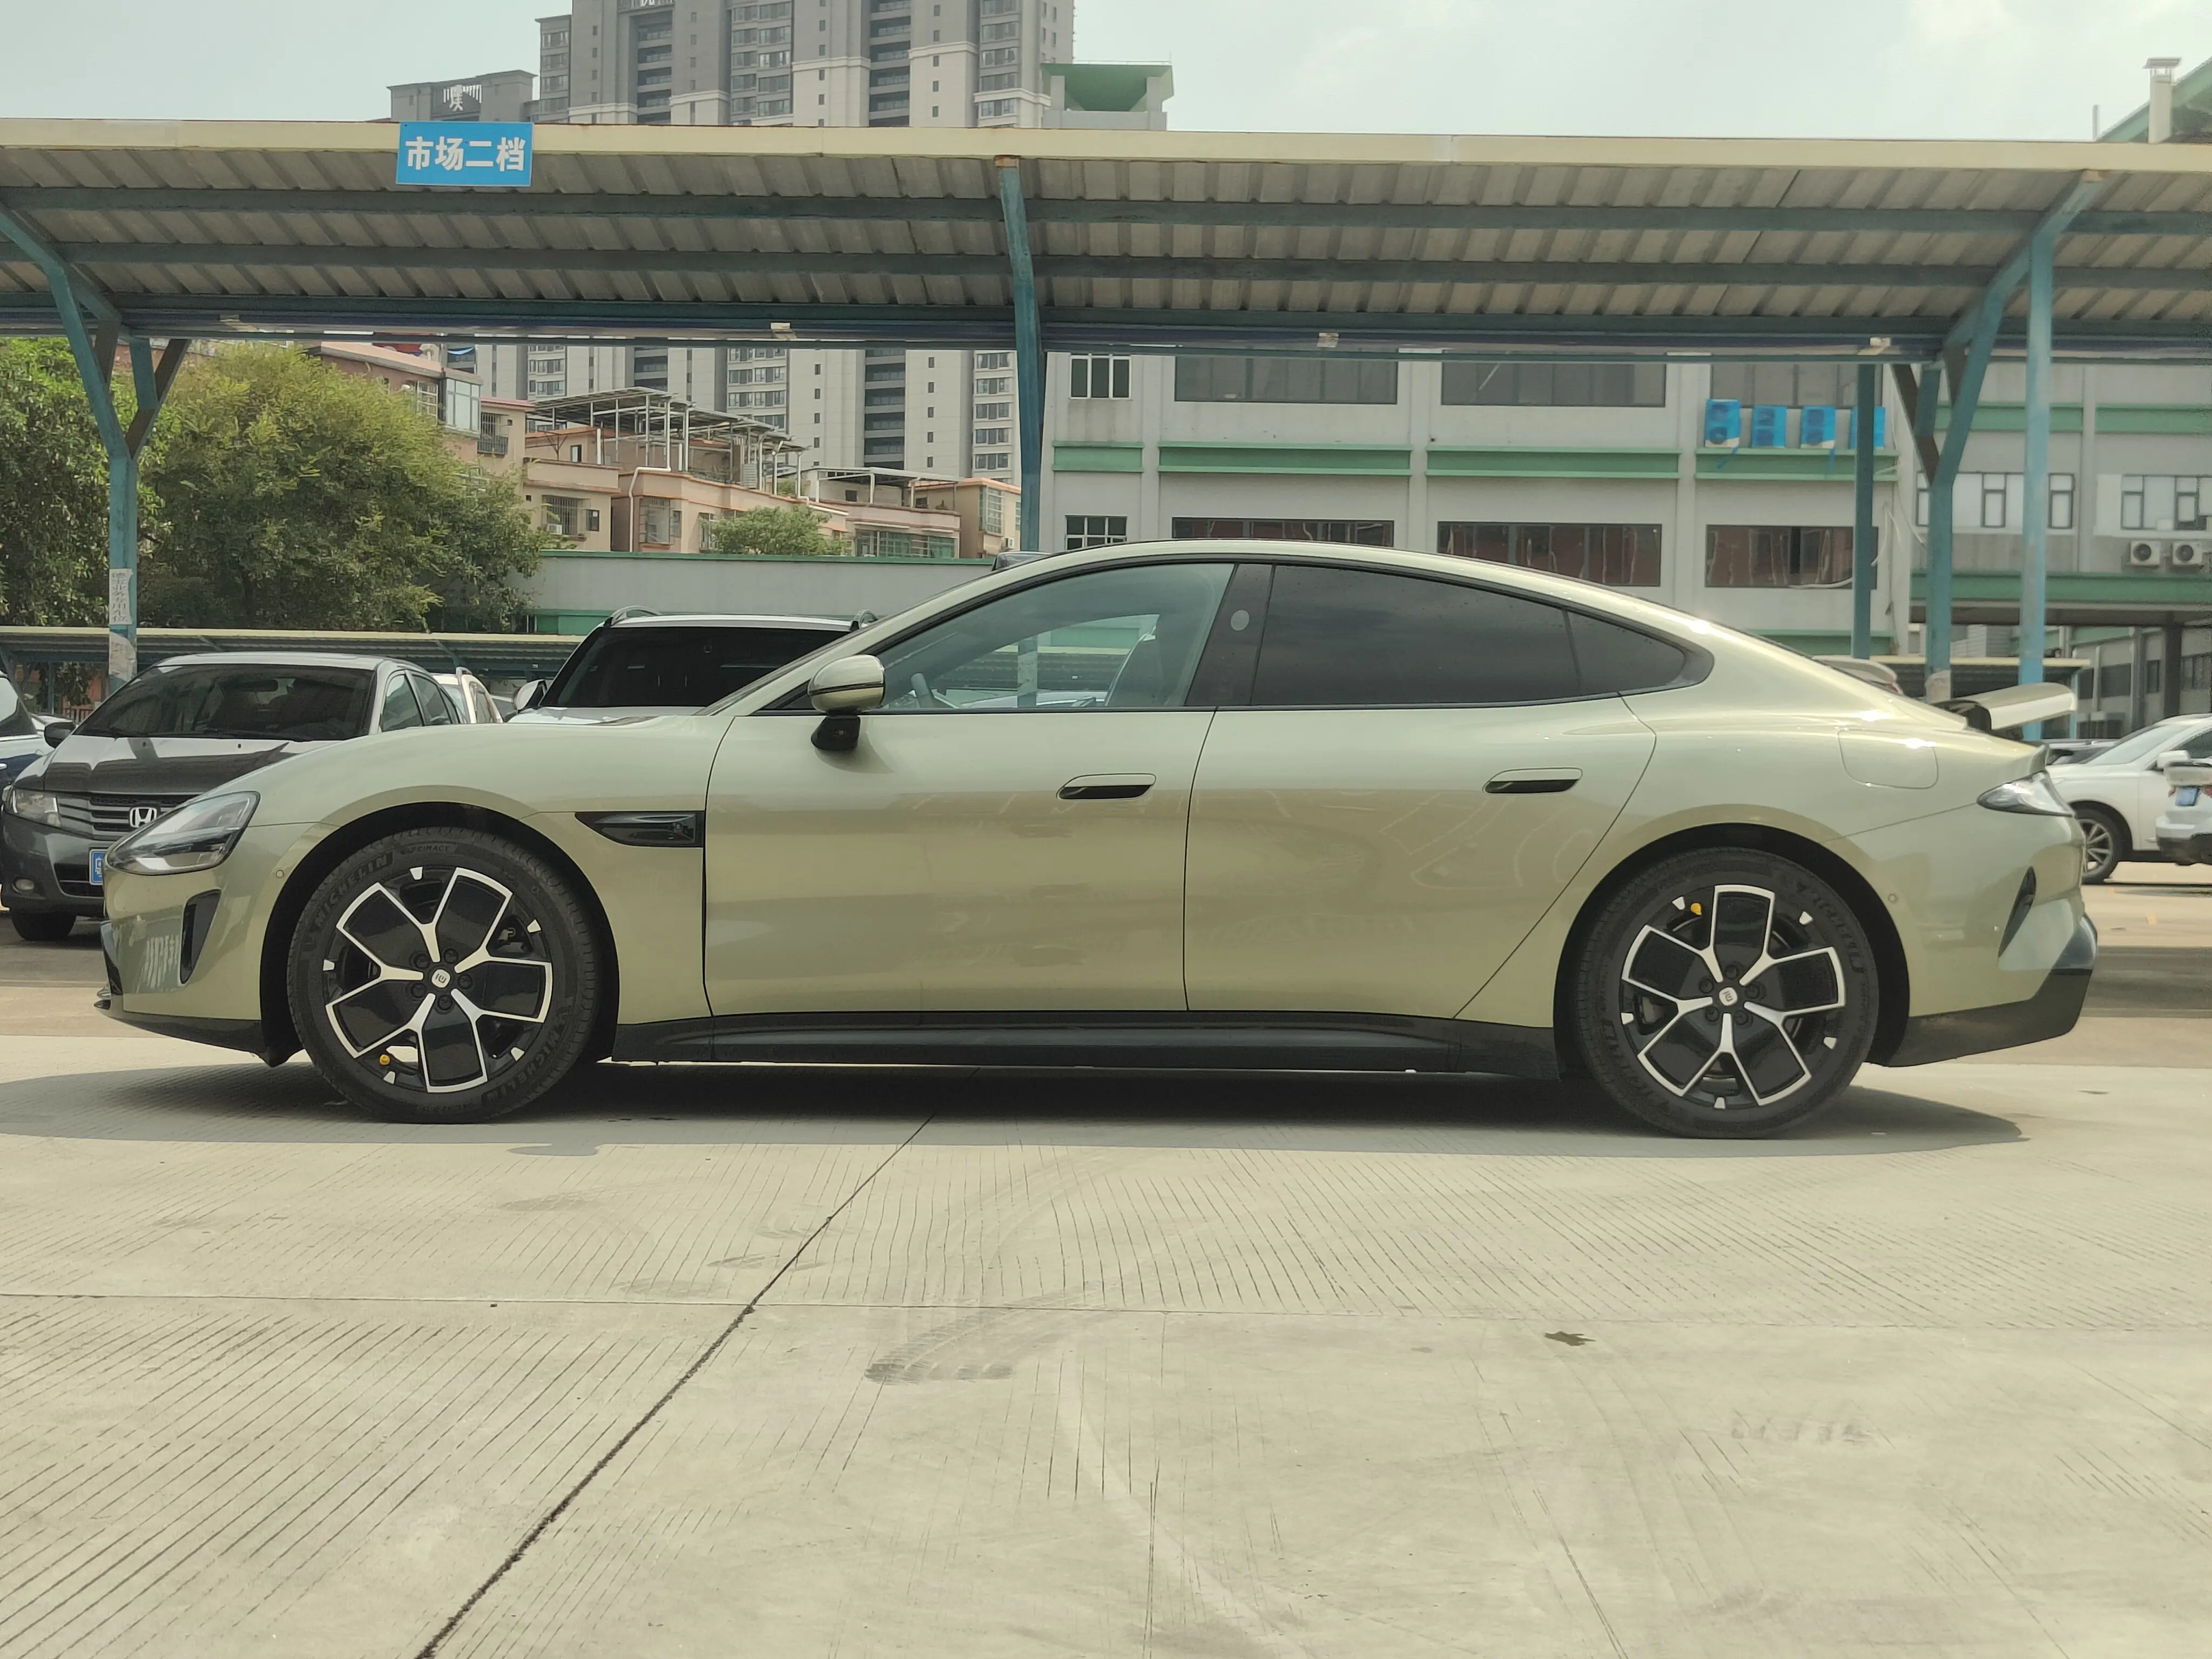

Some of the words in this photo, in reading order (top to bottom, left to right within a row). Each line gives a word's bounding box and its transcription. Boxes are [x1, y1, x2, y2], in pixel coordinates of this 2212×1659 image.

[406, 136, 525, 172] 市场二档
[313, 853, 389, 925] MICHELIN
